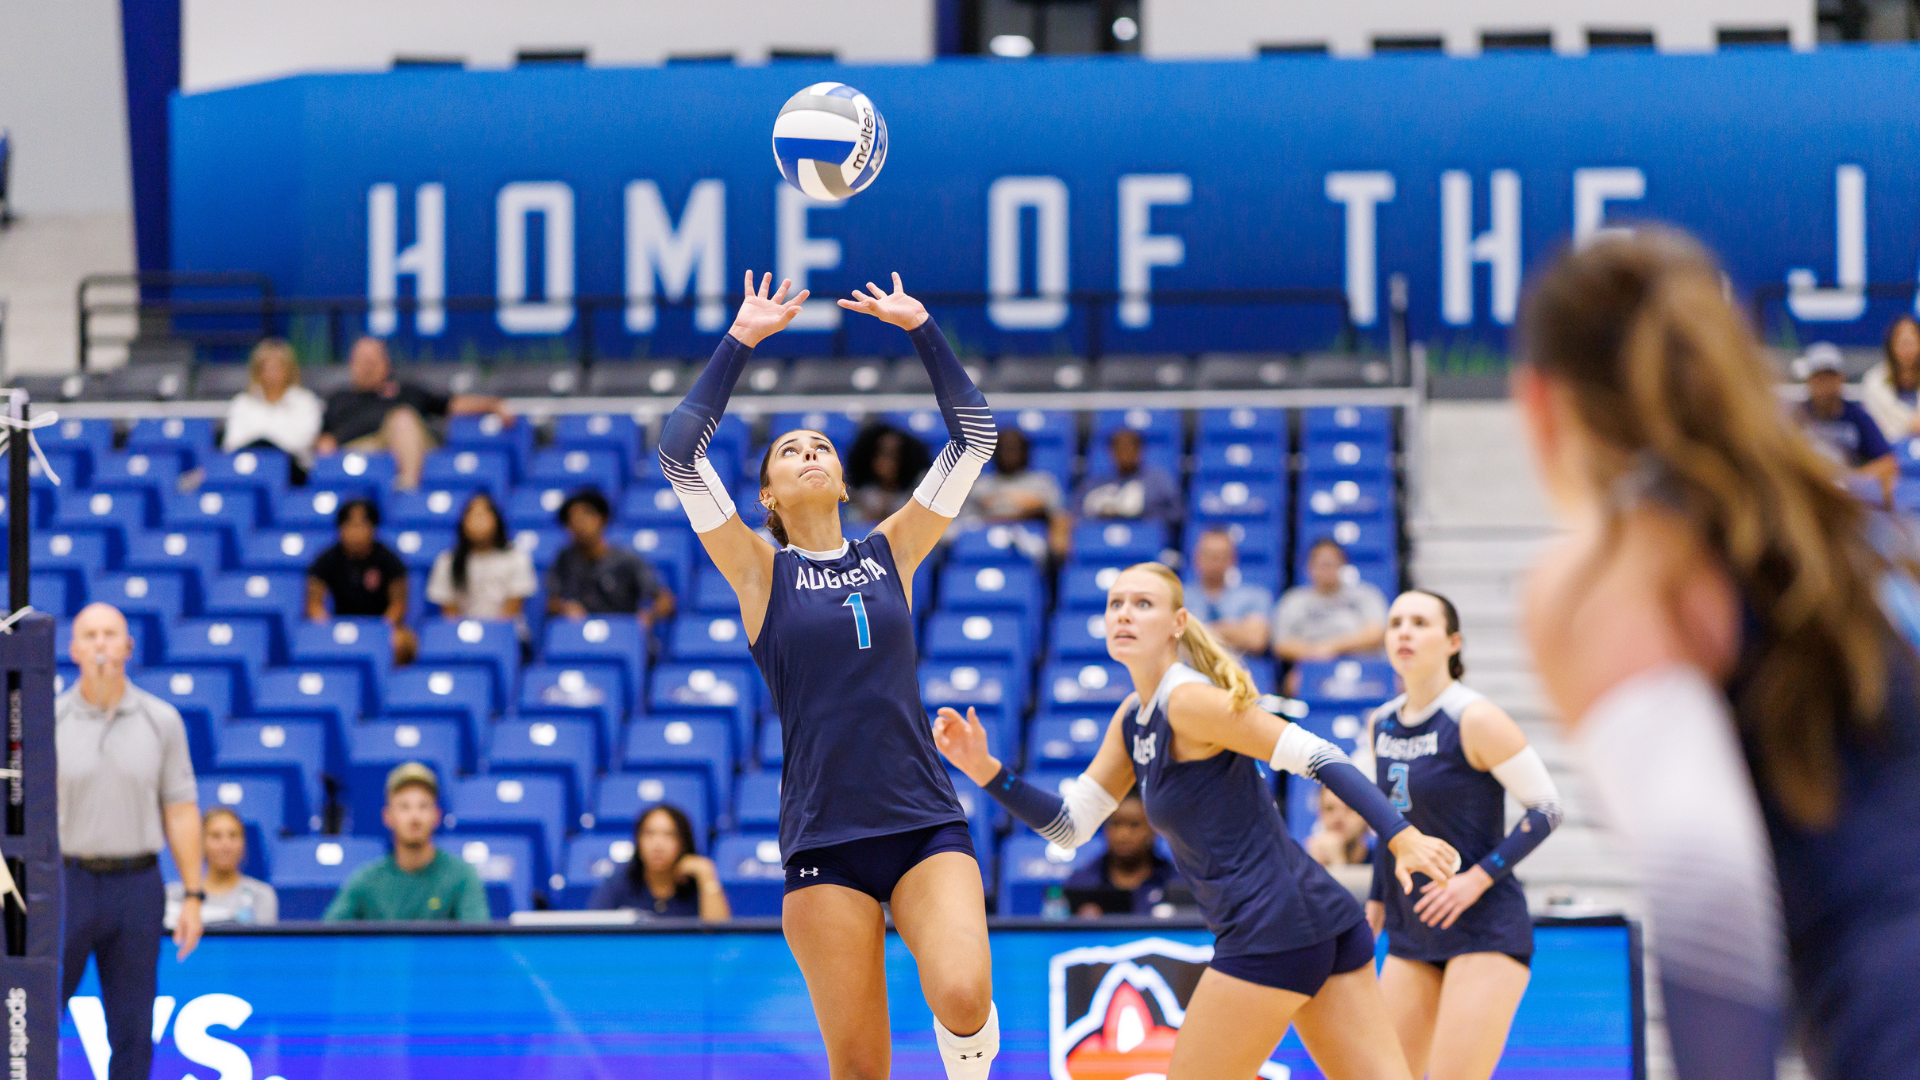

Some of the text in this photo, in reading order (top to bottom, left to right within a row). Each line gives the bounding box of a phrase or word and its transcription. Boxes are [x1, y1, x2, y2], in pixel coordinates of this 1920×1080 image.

[853, 108, 873, 169] molten
[366, 178, 844, 336] HOME
[986, 172, 1193, 331] OF
[1786, 163, 1920, 322] J
[842, 591, 871, 650] 1
[1387, 762, 1413, 813] 3
[68, 993, 284, 1080] VS
